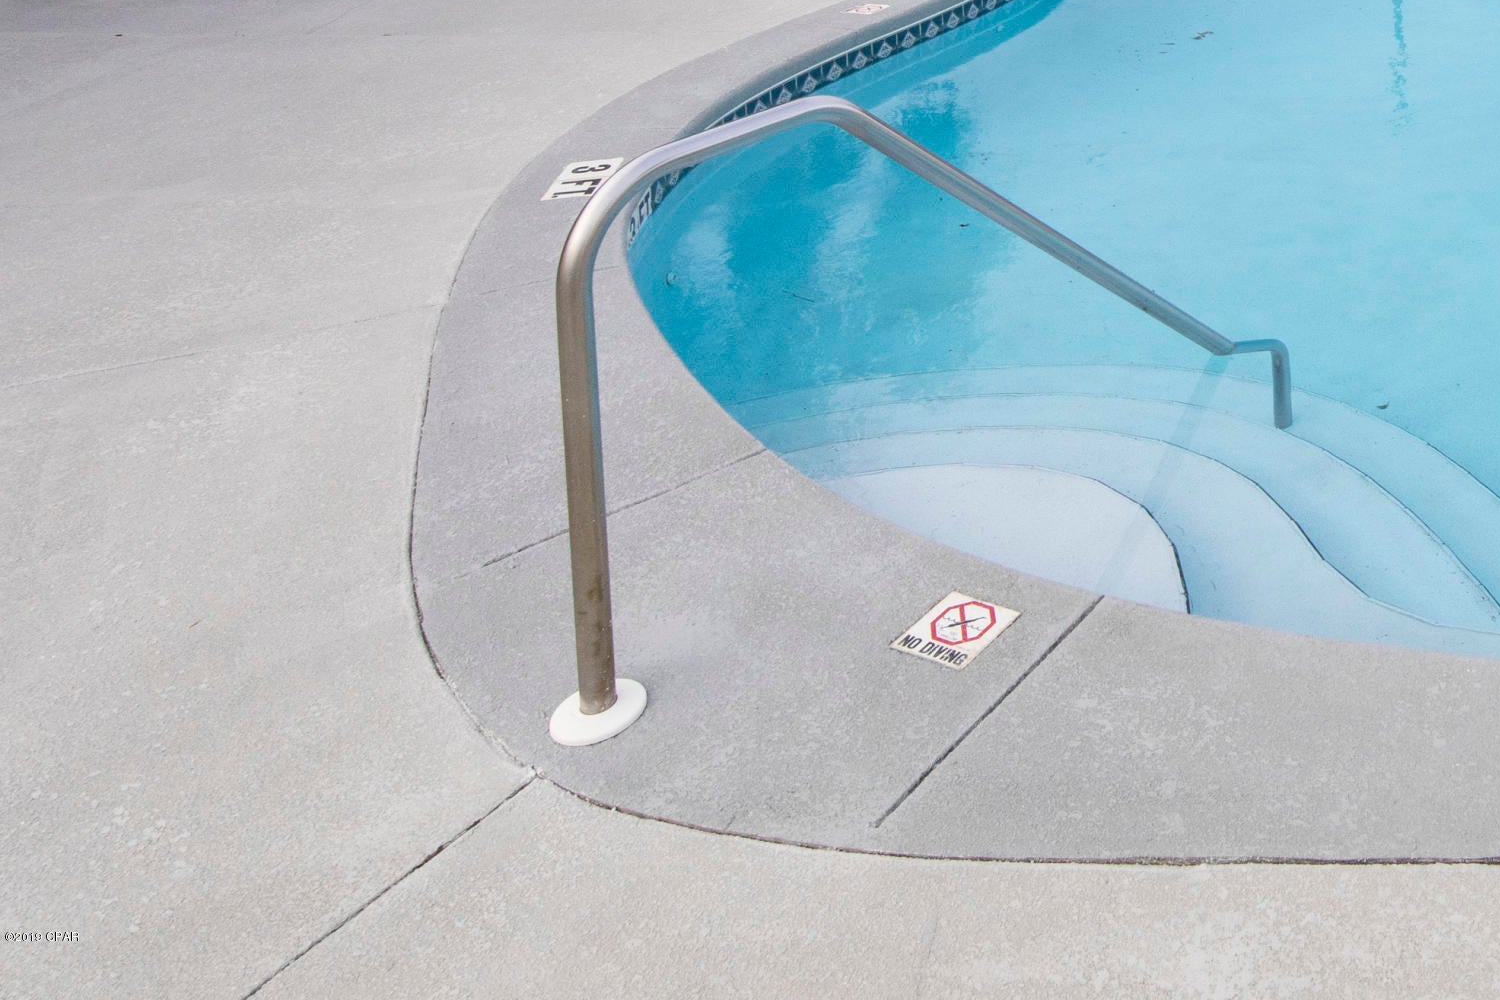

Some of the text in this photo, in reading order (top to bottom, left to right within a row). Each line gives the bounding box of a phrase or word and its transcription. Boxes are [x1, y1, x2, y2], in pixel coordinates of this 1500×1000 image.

[571, 164, 612, 174] 3
[898, 634, 922, 649] NO
[919, 641, 969, 665] DIVING
